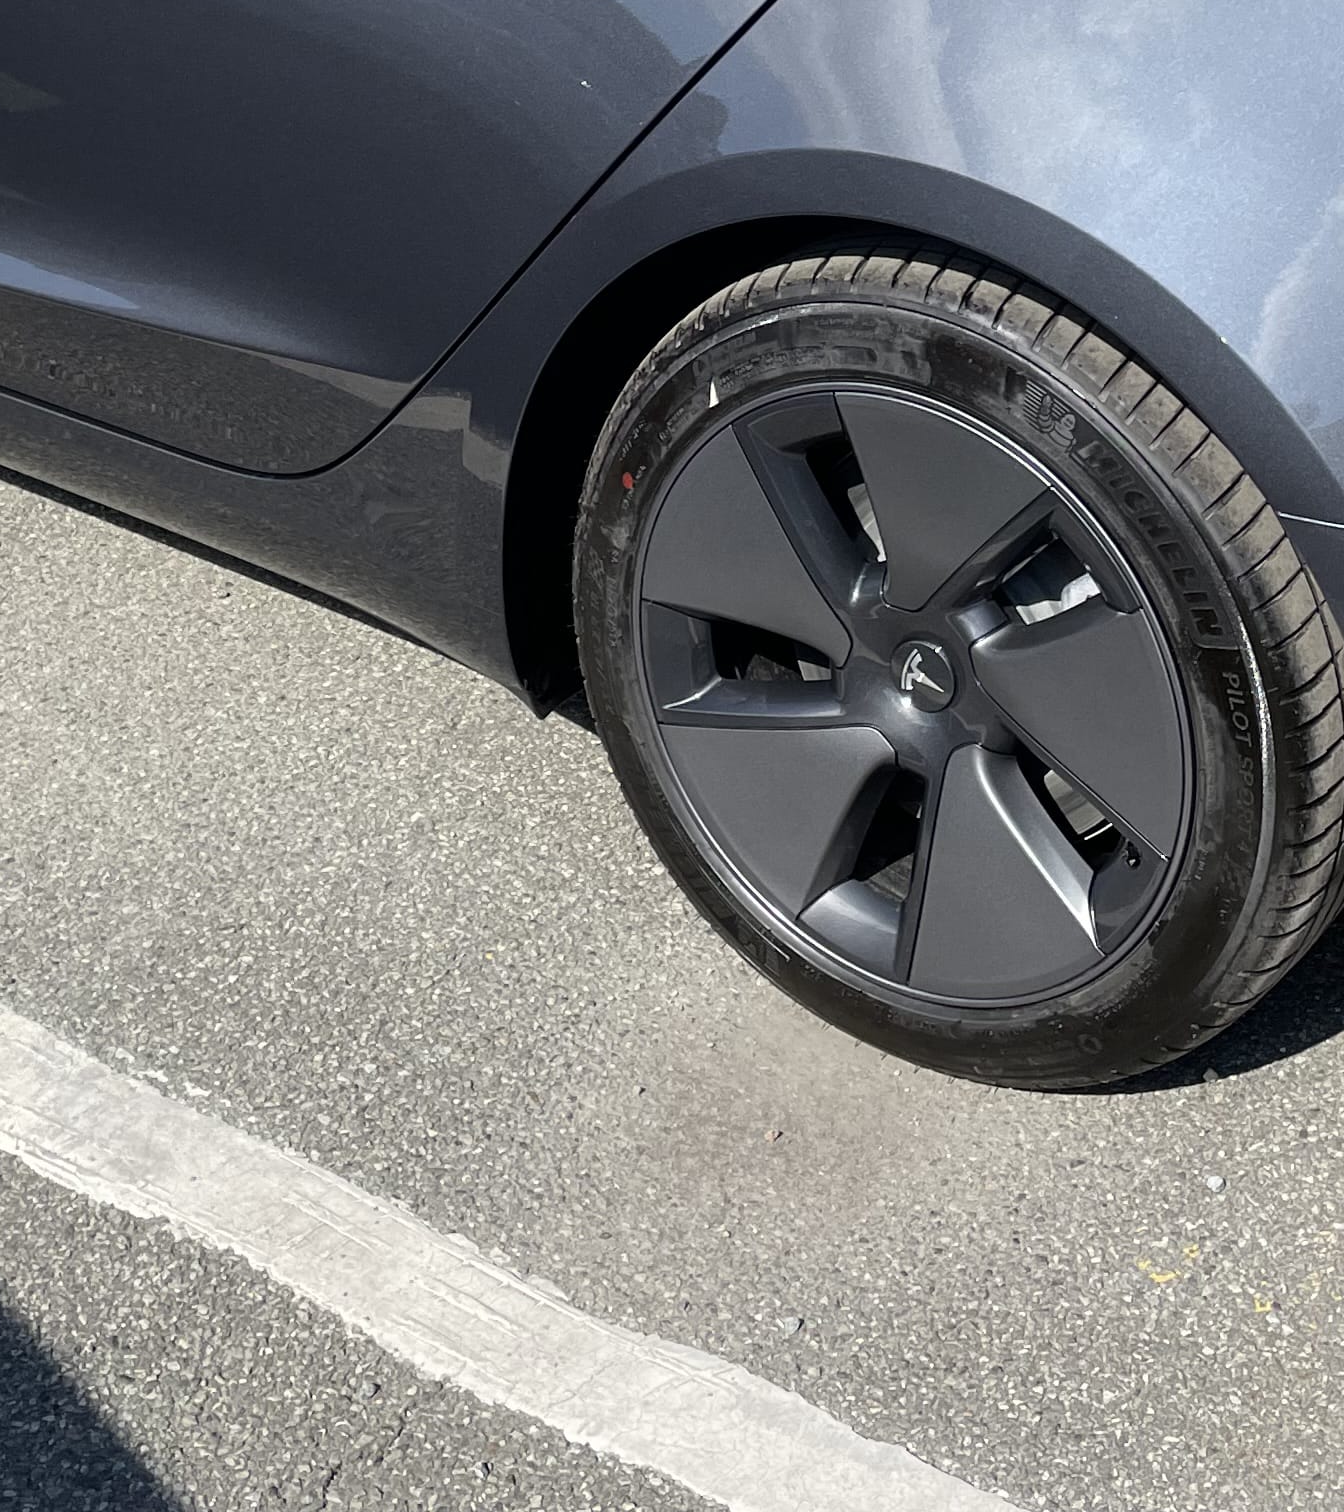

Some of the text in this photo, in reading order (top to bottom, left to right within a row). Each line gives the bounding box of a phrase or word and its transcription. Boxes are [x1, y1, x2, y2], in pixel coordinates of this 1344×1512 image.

[1077, 439, 1224, 637] MICHELIN
[1222, 671, 1253, 749] PILOT
[1236, 751, 1255, 841] SPORT
